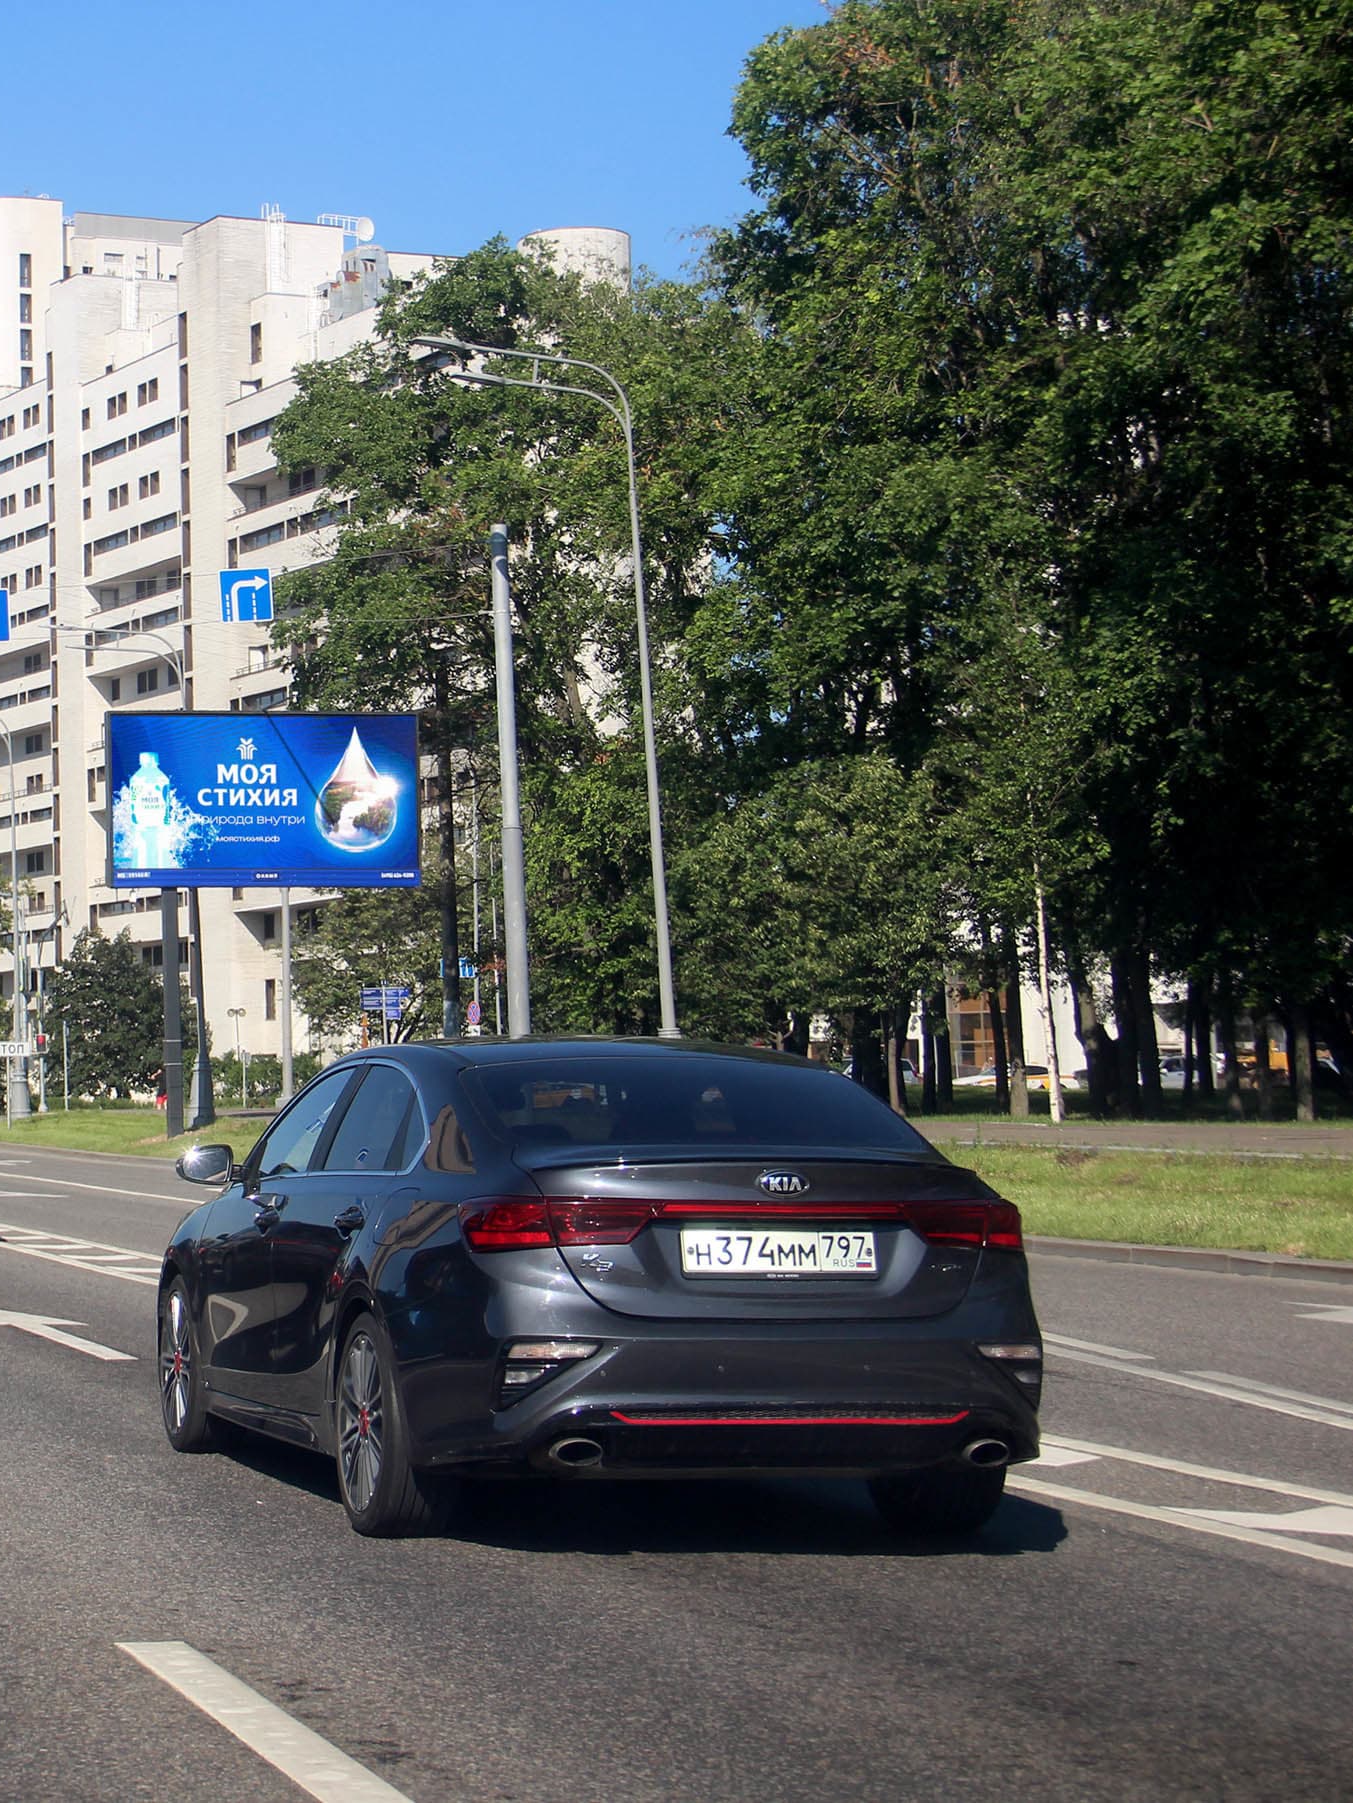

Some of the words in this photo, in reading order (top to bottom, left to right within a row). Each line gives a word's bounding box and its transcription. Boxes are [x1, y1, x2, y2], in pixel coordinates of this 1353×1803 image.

[217, 764, 277, 784] МОЯ
[197, 788, 298, 806] СТИХИЯ
[194, 815, 253, 826] рирода
[256, 815, 306, 826] внутри
[768, 1176, 802, 1192] KIA
[821, 1235, 866, 1260] 797
[832, 1258, 856, 1268] RUS
